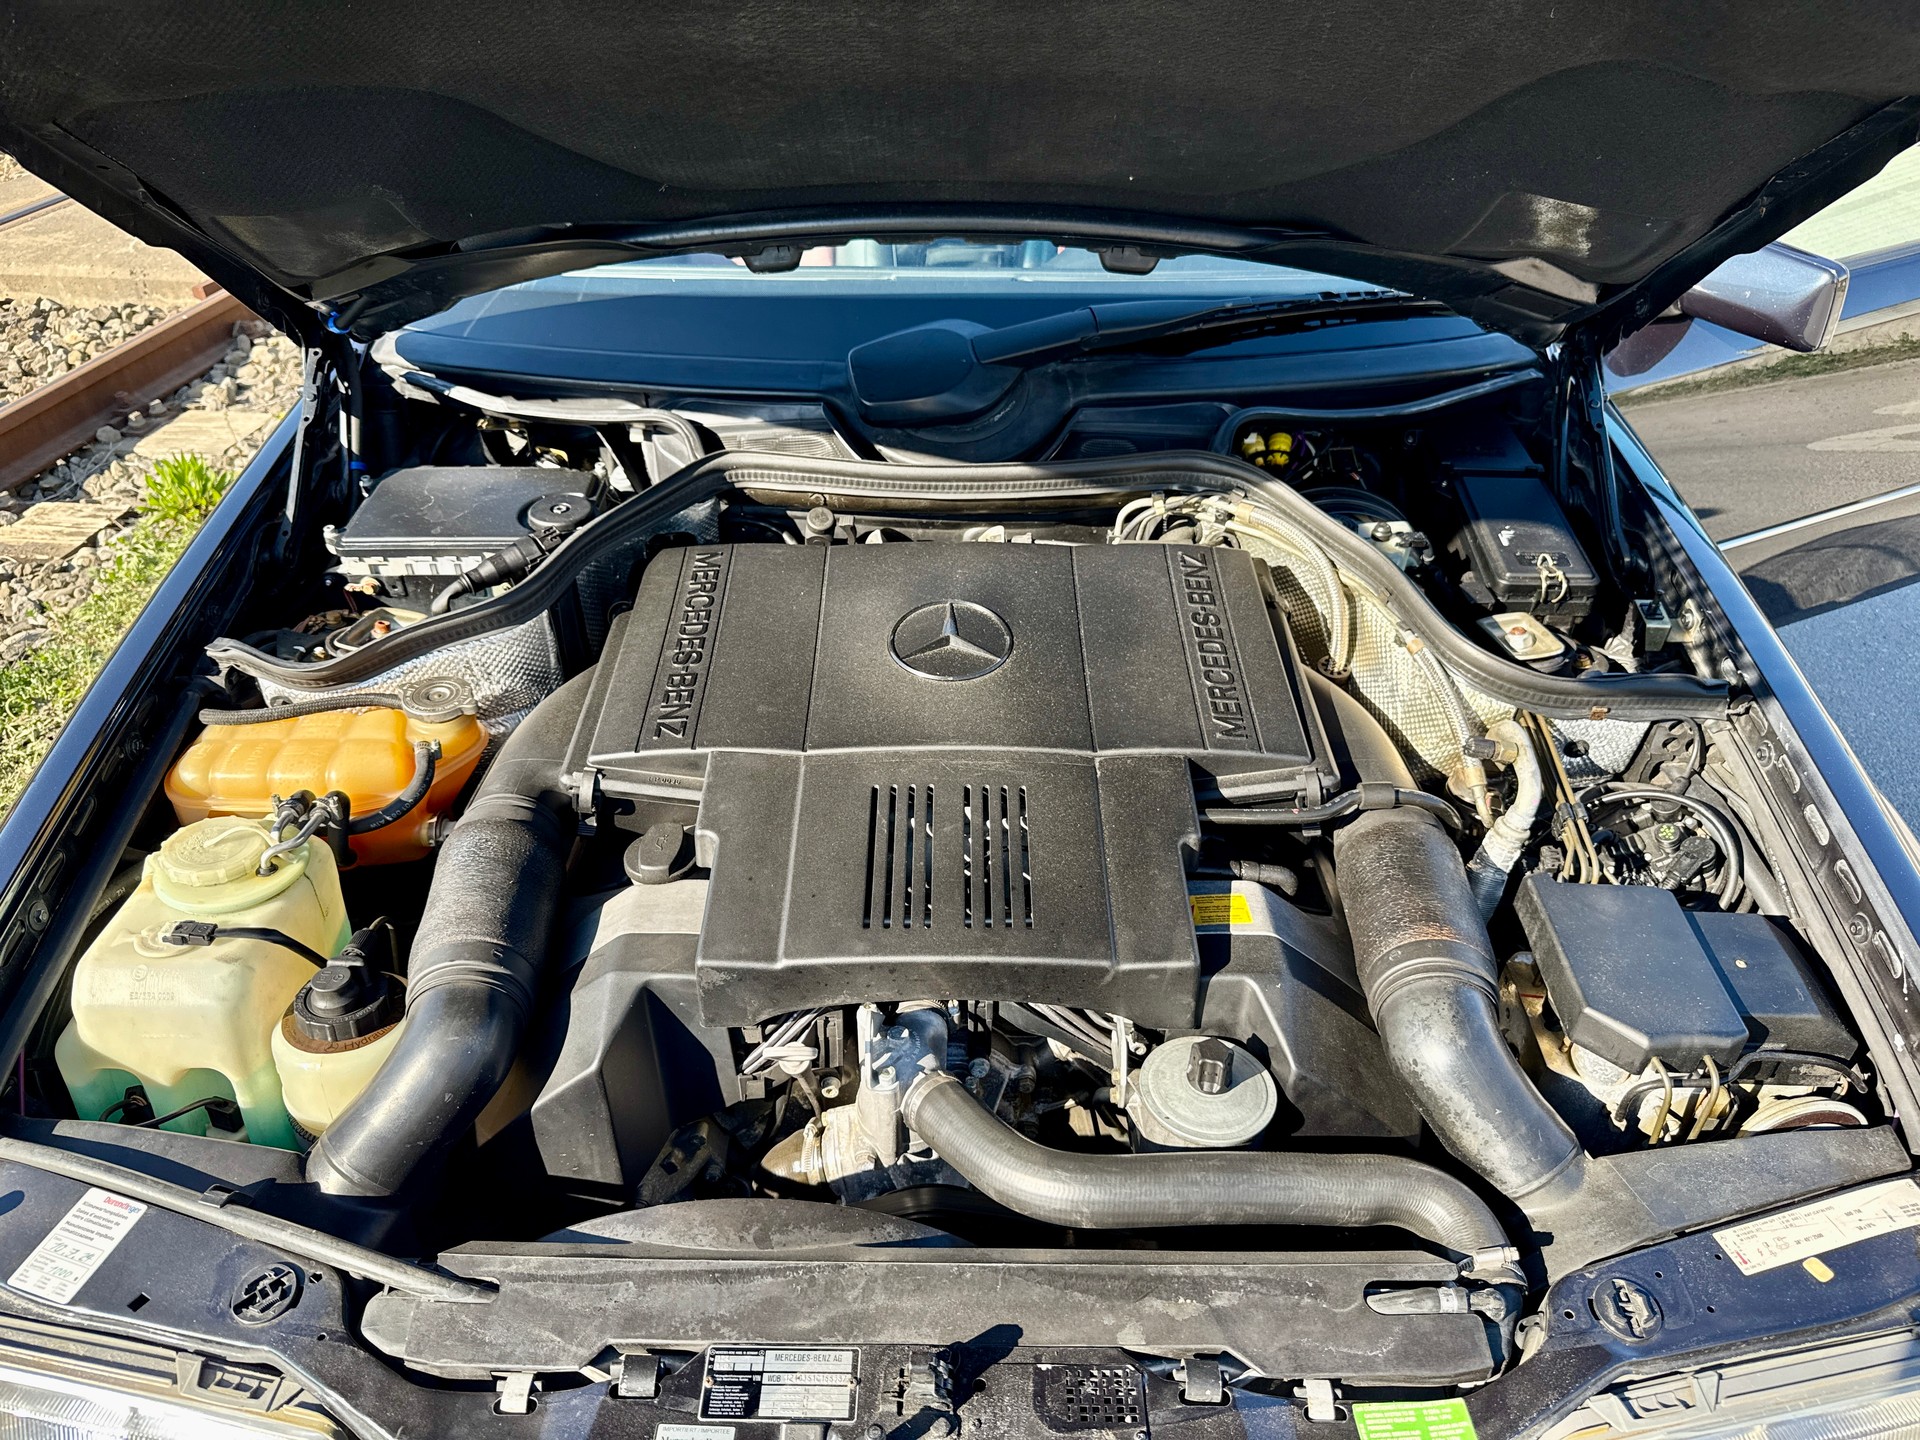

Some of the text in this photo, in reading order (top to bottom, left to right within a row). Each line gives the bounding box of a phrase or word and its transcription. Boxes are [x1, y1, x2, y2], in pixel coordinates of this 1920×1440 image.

[653, 552, 723, 740] MERCEDES-BENZ
[1178, 551, 1248, 739] MERCEDES-BENZ
[103, 1196, 142, 1214] Derendinger
[775, 1353, 843, 1362] MERCEDES-BENZ AG
